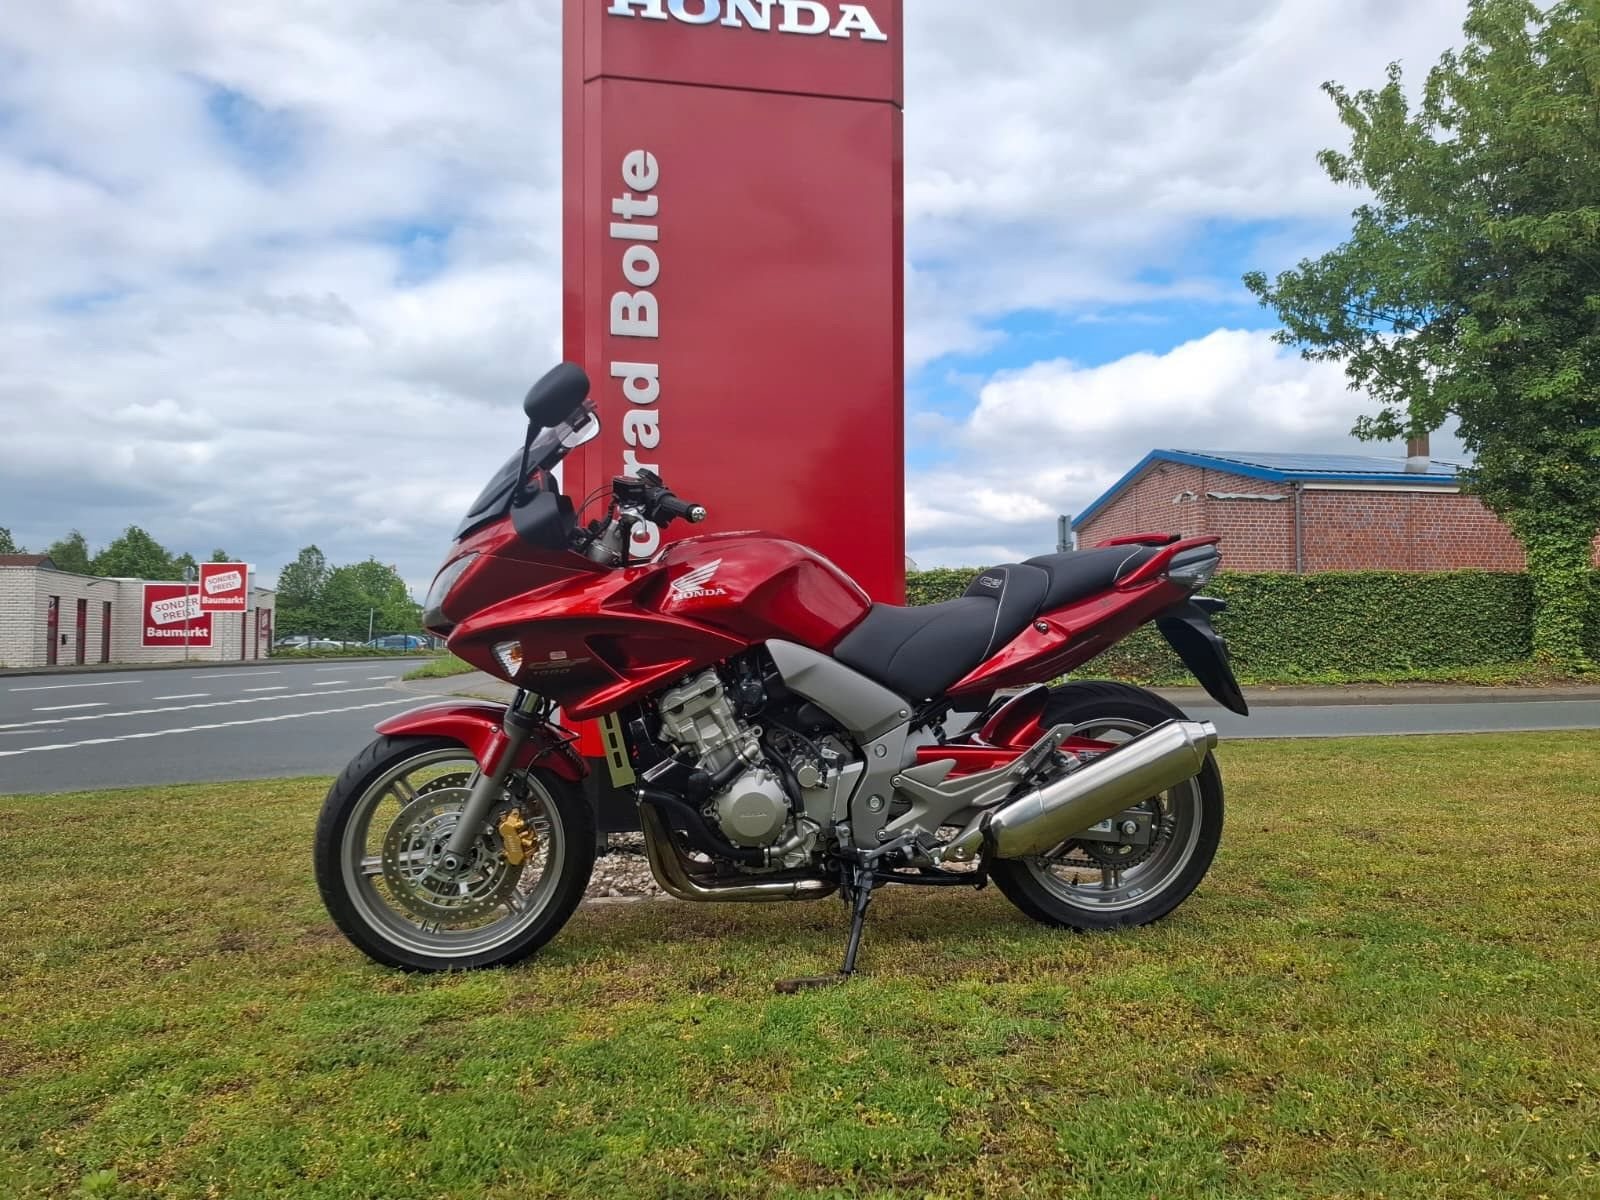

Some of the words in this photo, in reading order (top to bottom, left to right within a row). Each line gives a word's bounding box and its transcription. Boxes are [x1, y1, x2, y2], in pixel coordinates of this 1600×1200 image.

[607, 0, 888, 41] HONDA
[610, 149, 660, 338] Bolte
[207, 573, 238, 584] SONDER
[202, 596, 244, 604] Baumarkt
[672, 588, 728, 601] HONDA
[154, 597, 199, 613] SONDER
[162, 607, 196, 621] PREIS!
[147, 627, 208, 637] Baumarkt
